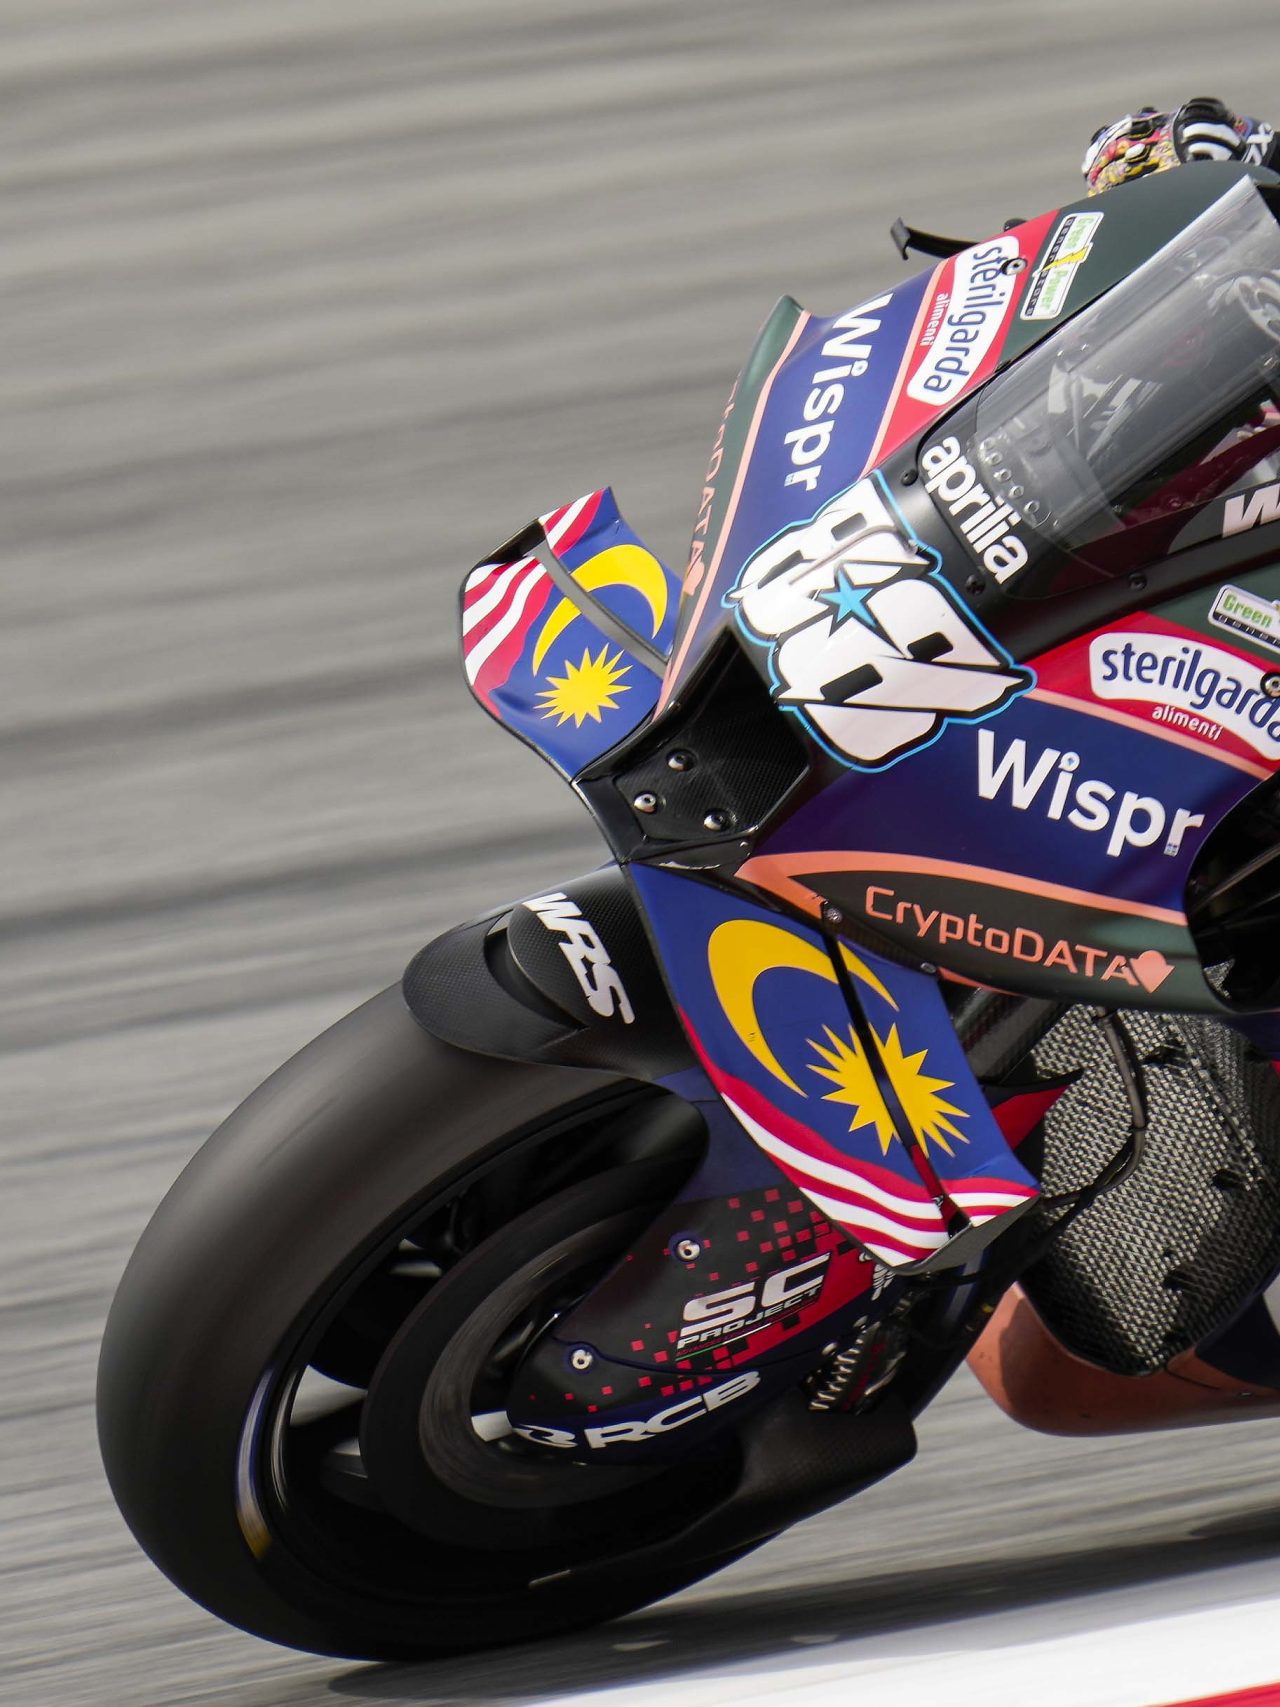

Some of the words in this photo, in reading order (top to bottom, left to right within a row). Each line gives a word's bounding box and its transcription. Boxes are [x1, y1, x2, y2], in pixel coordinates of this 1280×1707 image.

[919, 292, 951, 348] alimenti
[922, 241, 1006, 395] sterilgarda
[783, 292, 895, 492] Wispr
[921, 436, 1028, 585] aprilia
[728, 478, 1027, 763] 88
[1222, 593, 1273, 629] Green
[1151, 702, 1225, 742] alimenti
[977, 728, 1205, 858] Wispr
[521, 892, 636, 1025] WRS
[865, 885, 1140, 986] CryptoDATA
[676, 1284, 822, 1350] PROJECT
[680, 1252, 831, 1337] SC
